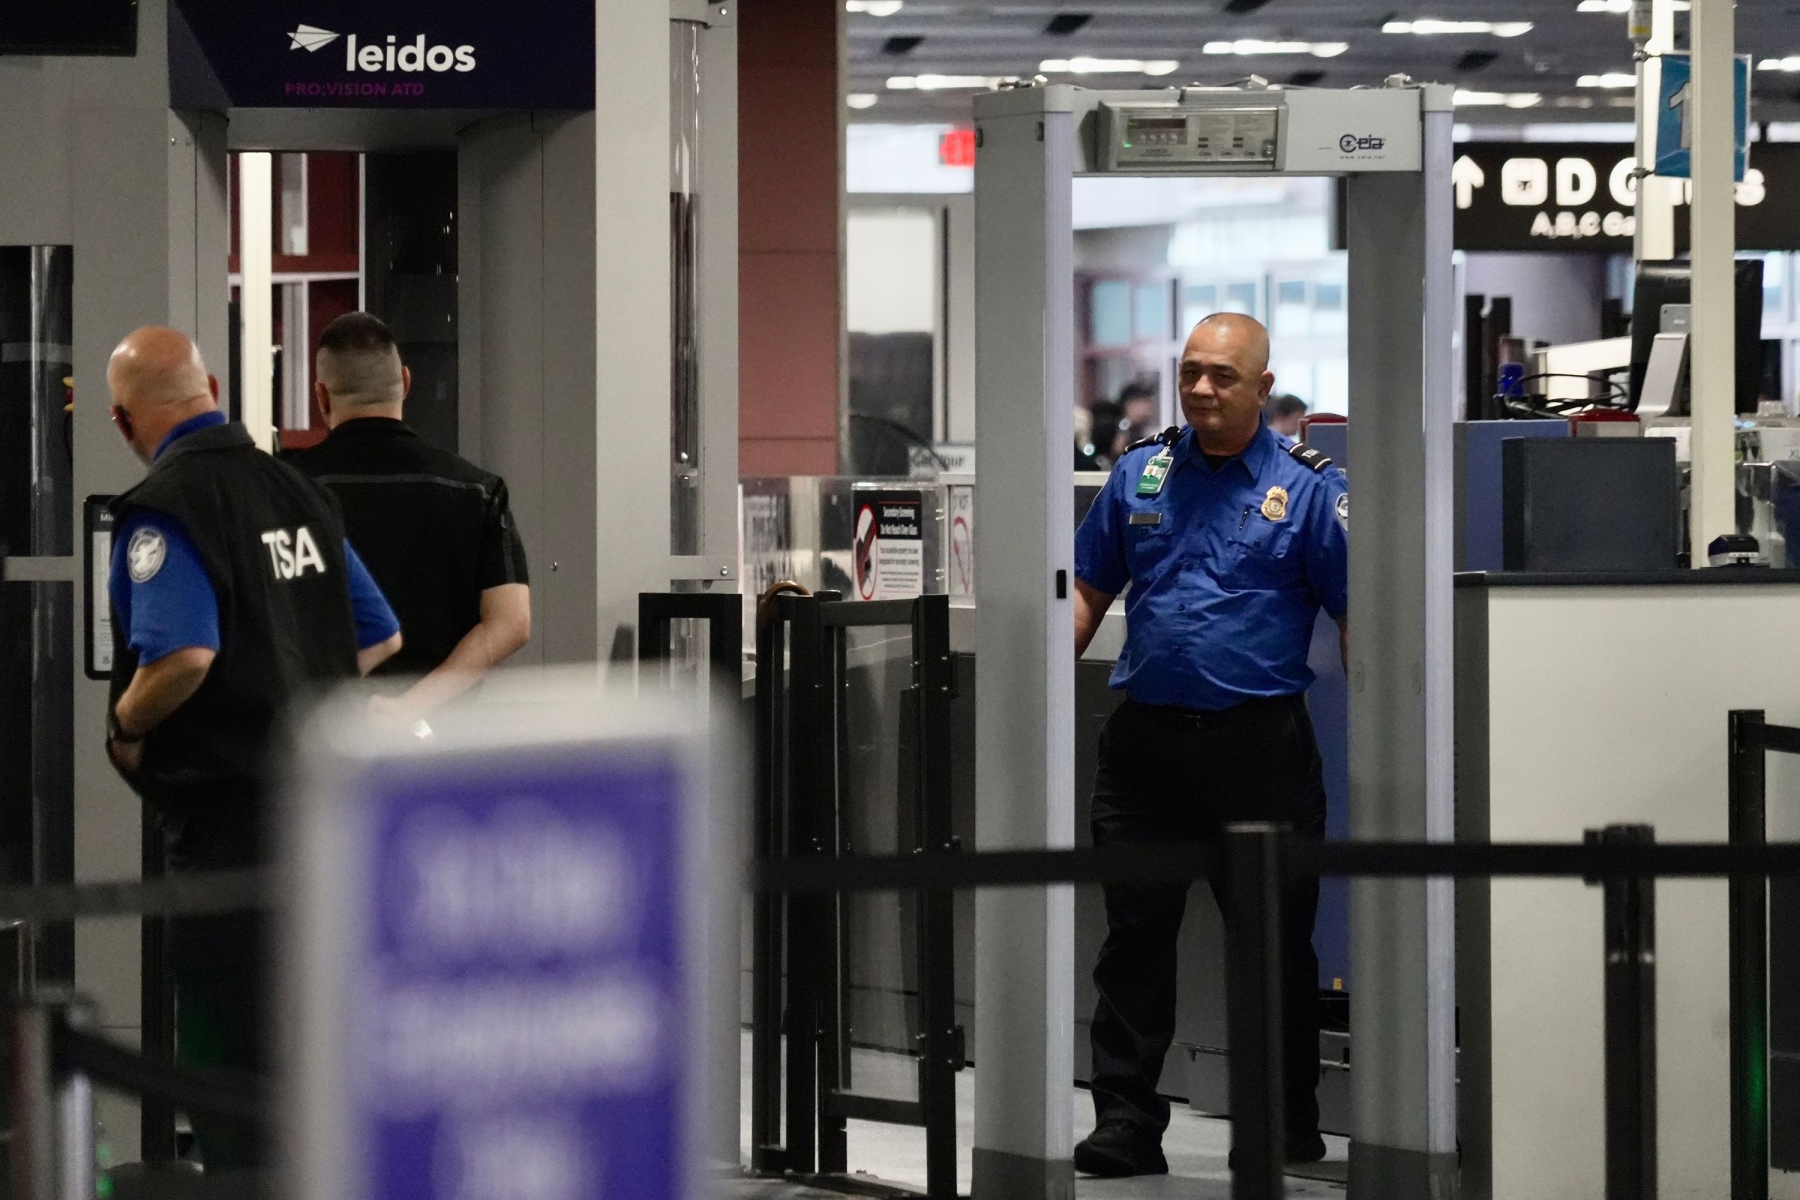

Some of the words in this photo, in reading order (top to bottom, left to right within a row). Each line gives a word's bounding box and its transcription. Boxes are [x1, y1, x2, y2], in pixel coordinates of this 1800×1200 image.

[346, 34, 476, 72] leidos
[391, 82, 424, 96] ATD
[1556, 158, 1597, 206] D
[261, 527, 325, 579] TSA
